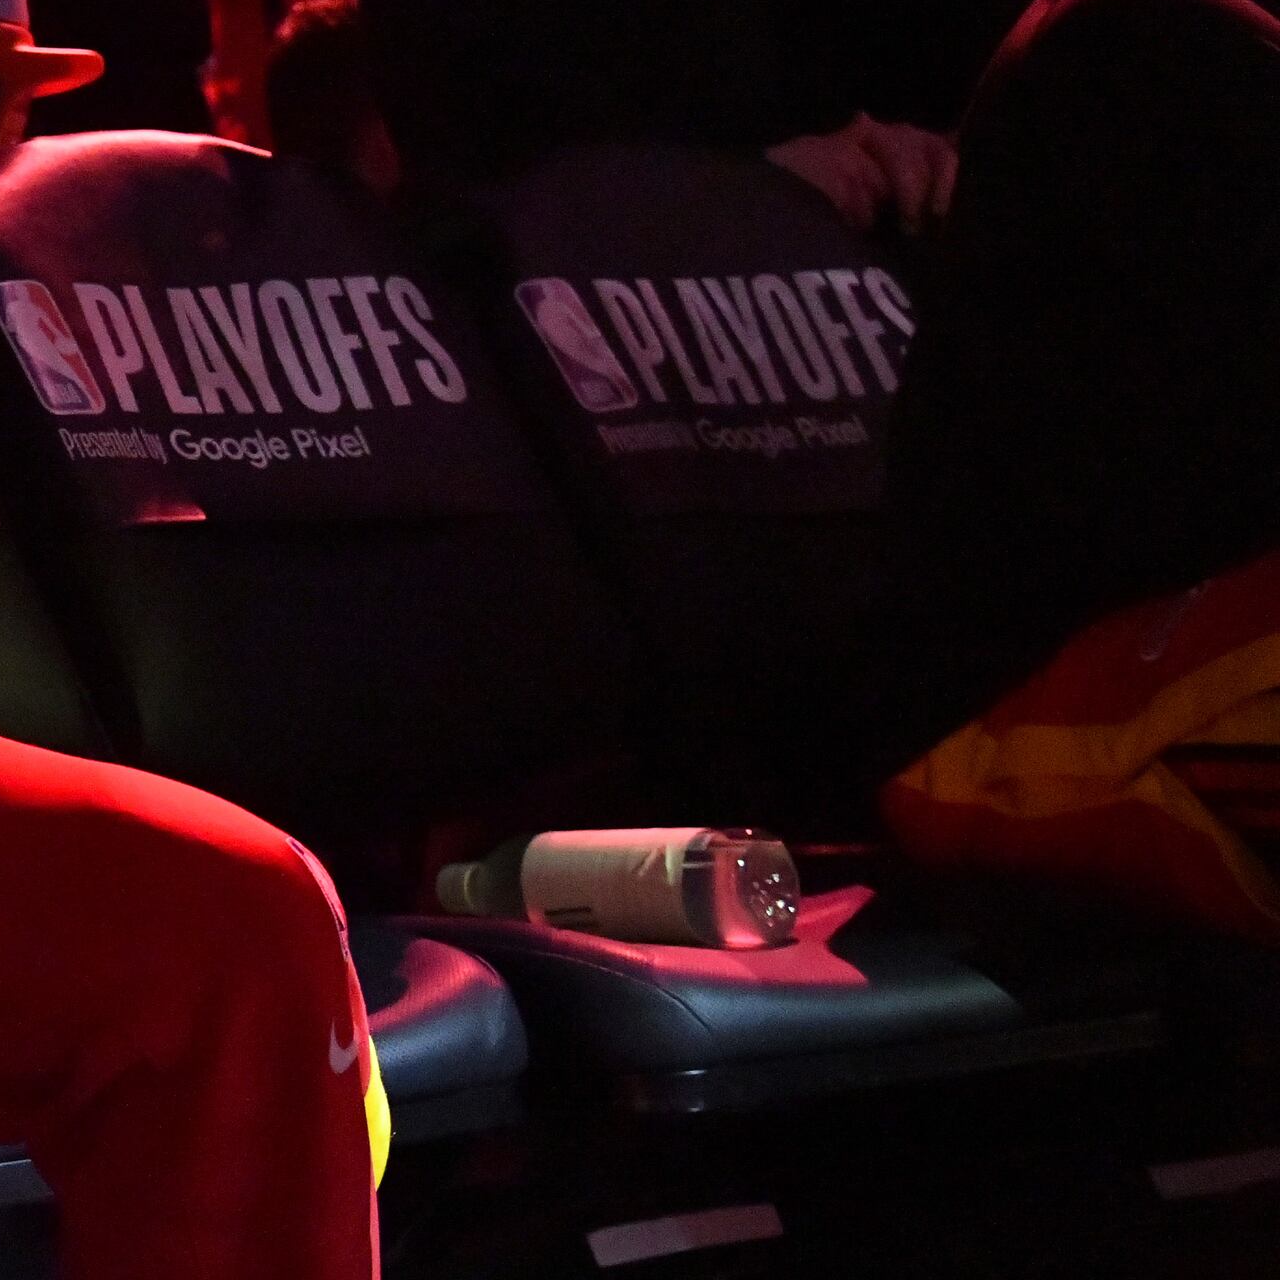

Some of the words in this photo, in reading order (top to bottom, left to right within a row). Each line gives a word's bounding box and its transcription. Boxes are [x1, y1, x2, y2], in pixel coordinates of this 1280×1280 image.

[72, 275, 468, 414] PLAYOFFS
[169, 428, 290, 469] Google
[291, 425, 371, 459] Pixel
